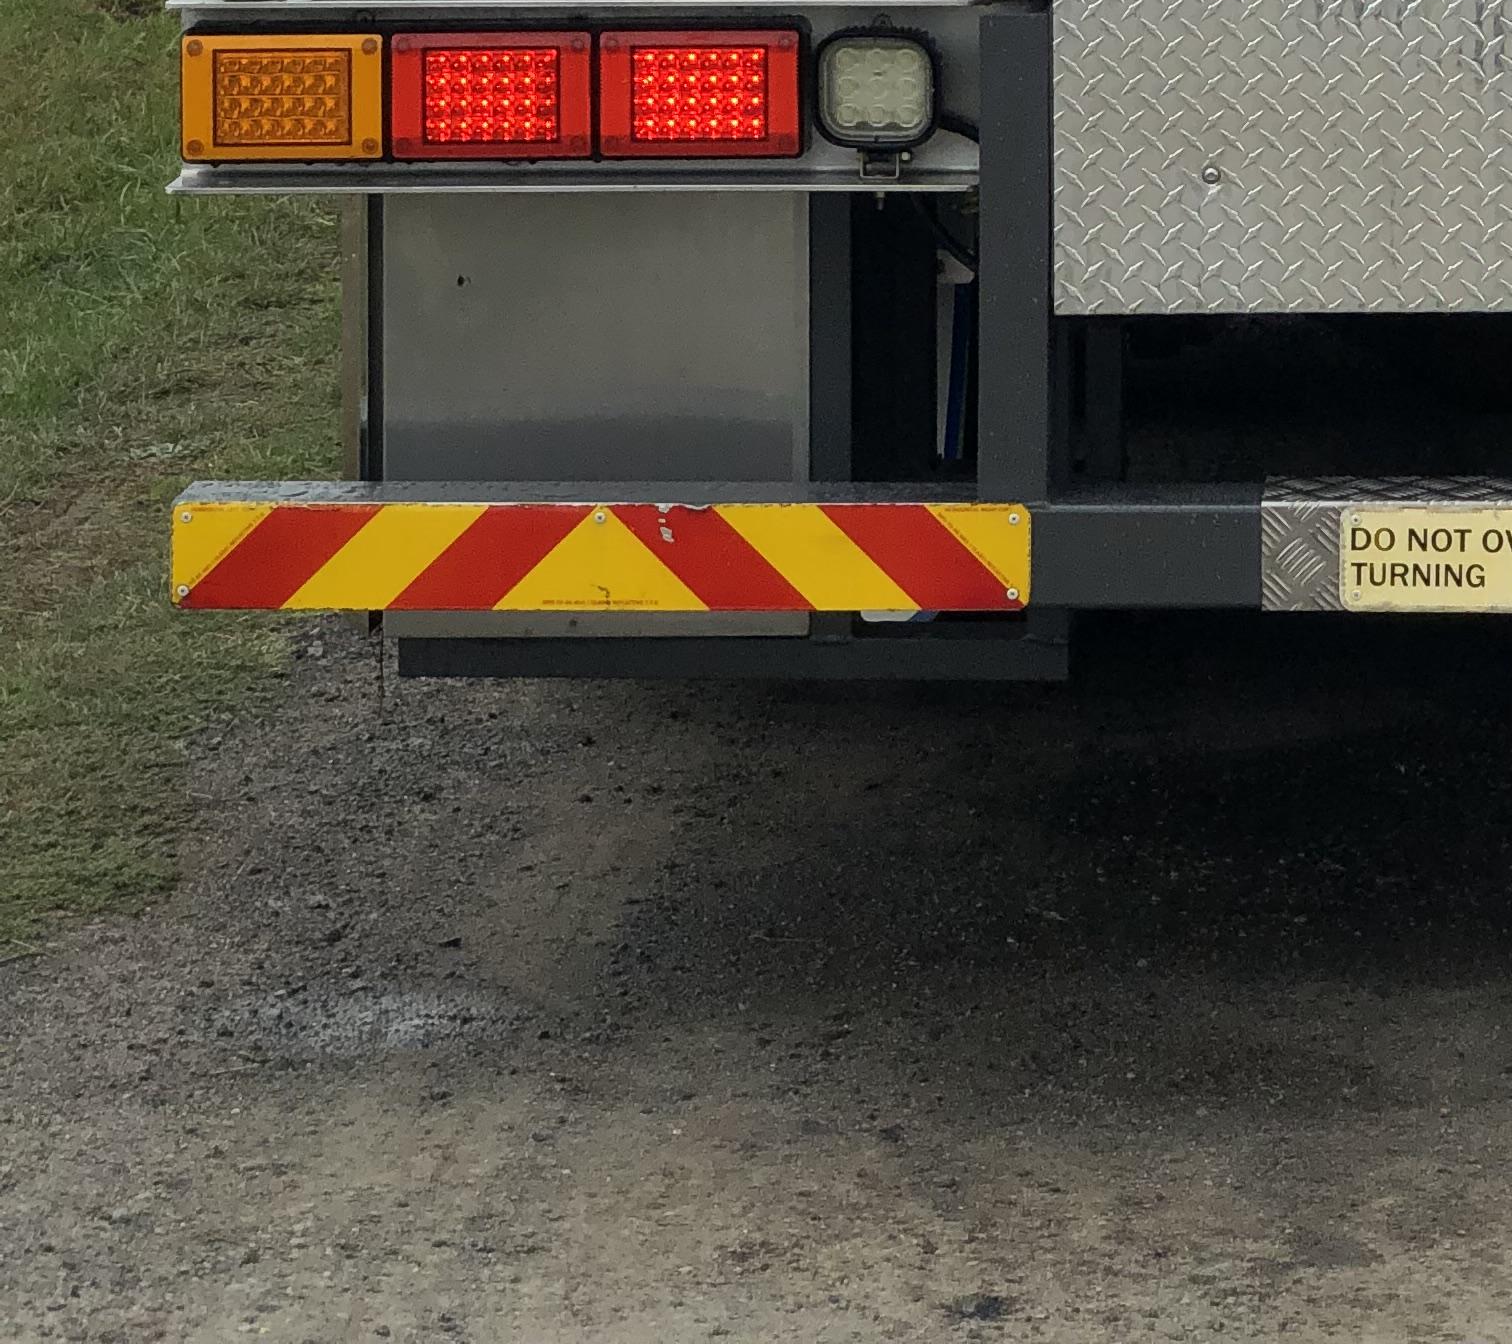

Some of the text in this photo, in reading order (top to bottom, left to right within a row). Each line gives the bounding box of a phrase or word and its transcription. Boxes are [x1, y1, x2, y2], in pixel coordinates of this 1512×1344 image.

[1350, 527, 1396, 552] DO
[1407, 528, 1473, 553] NOT
[1350, 562, 1486, 588] TURNING
